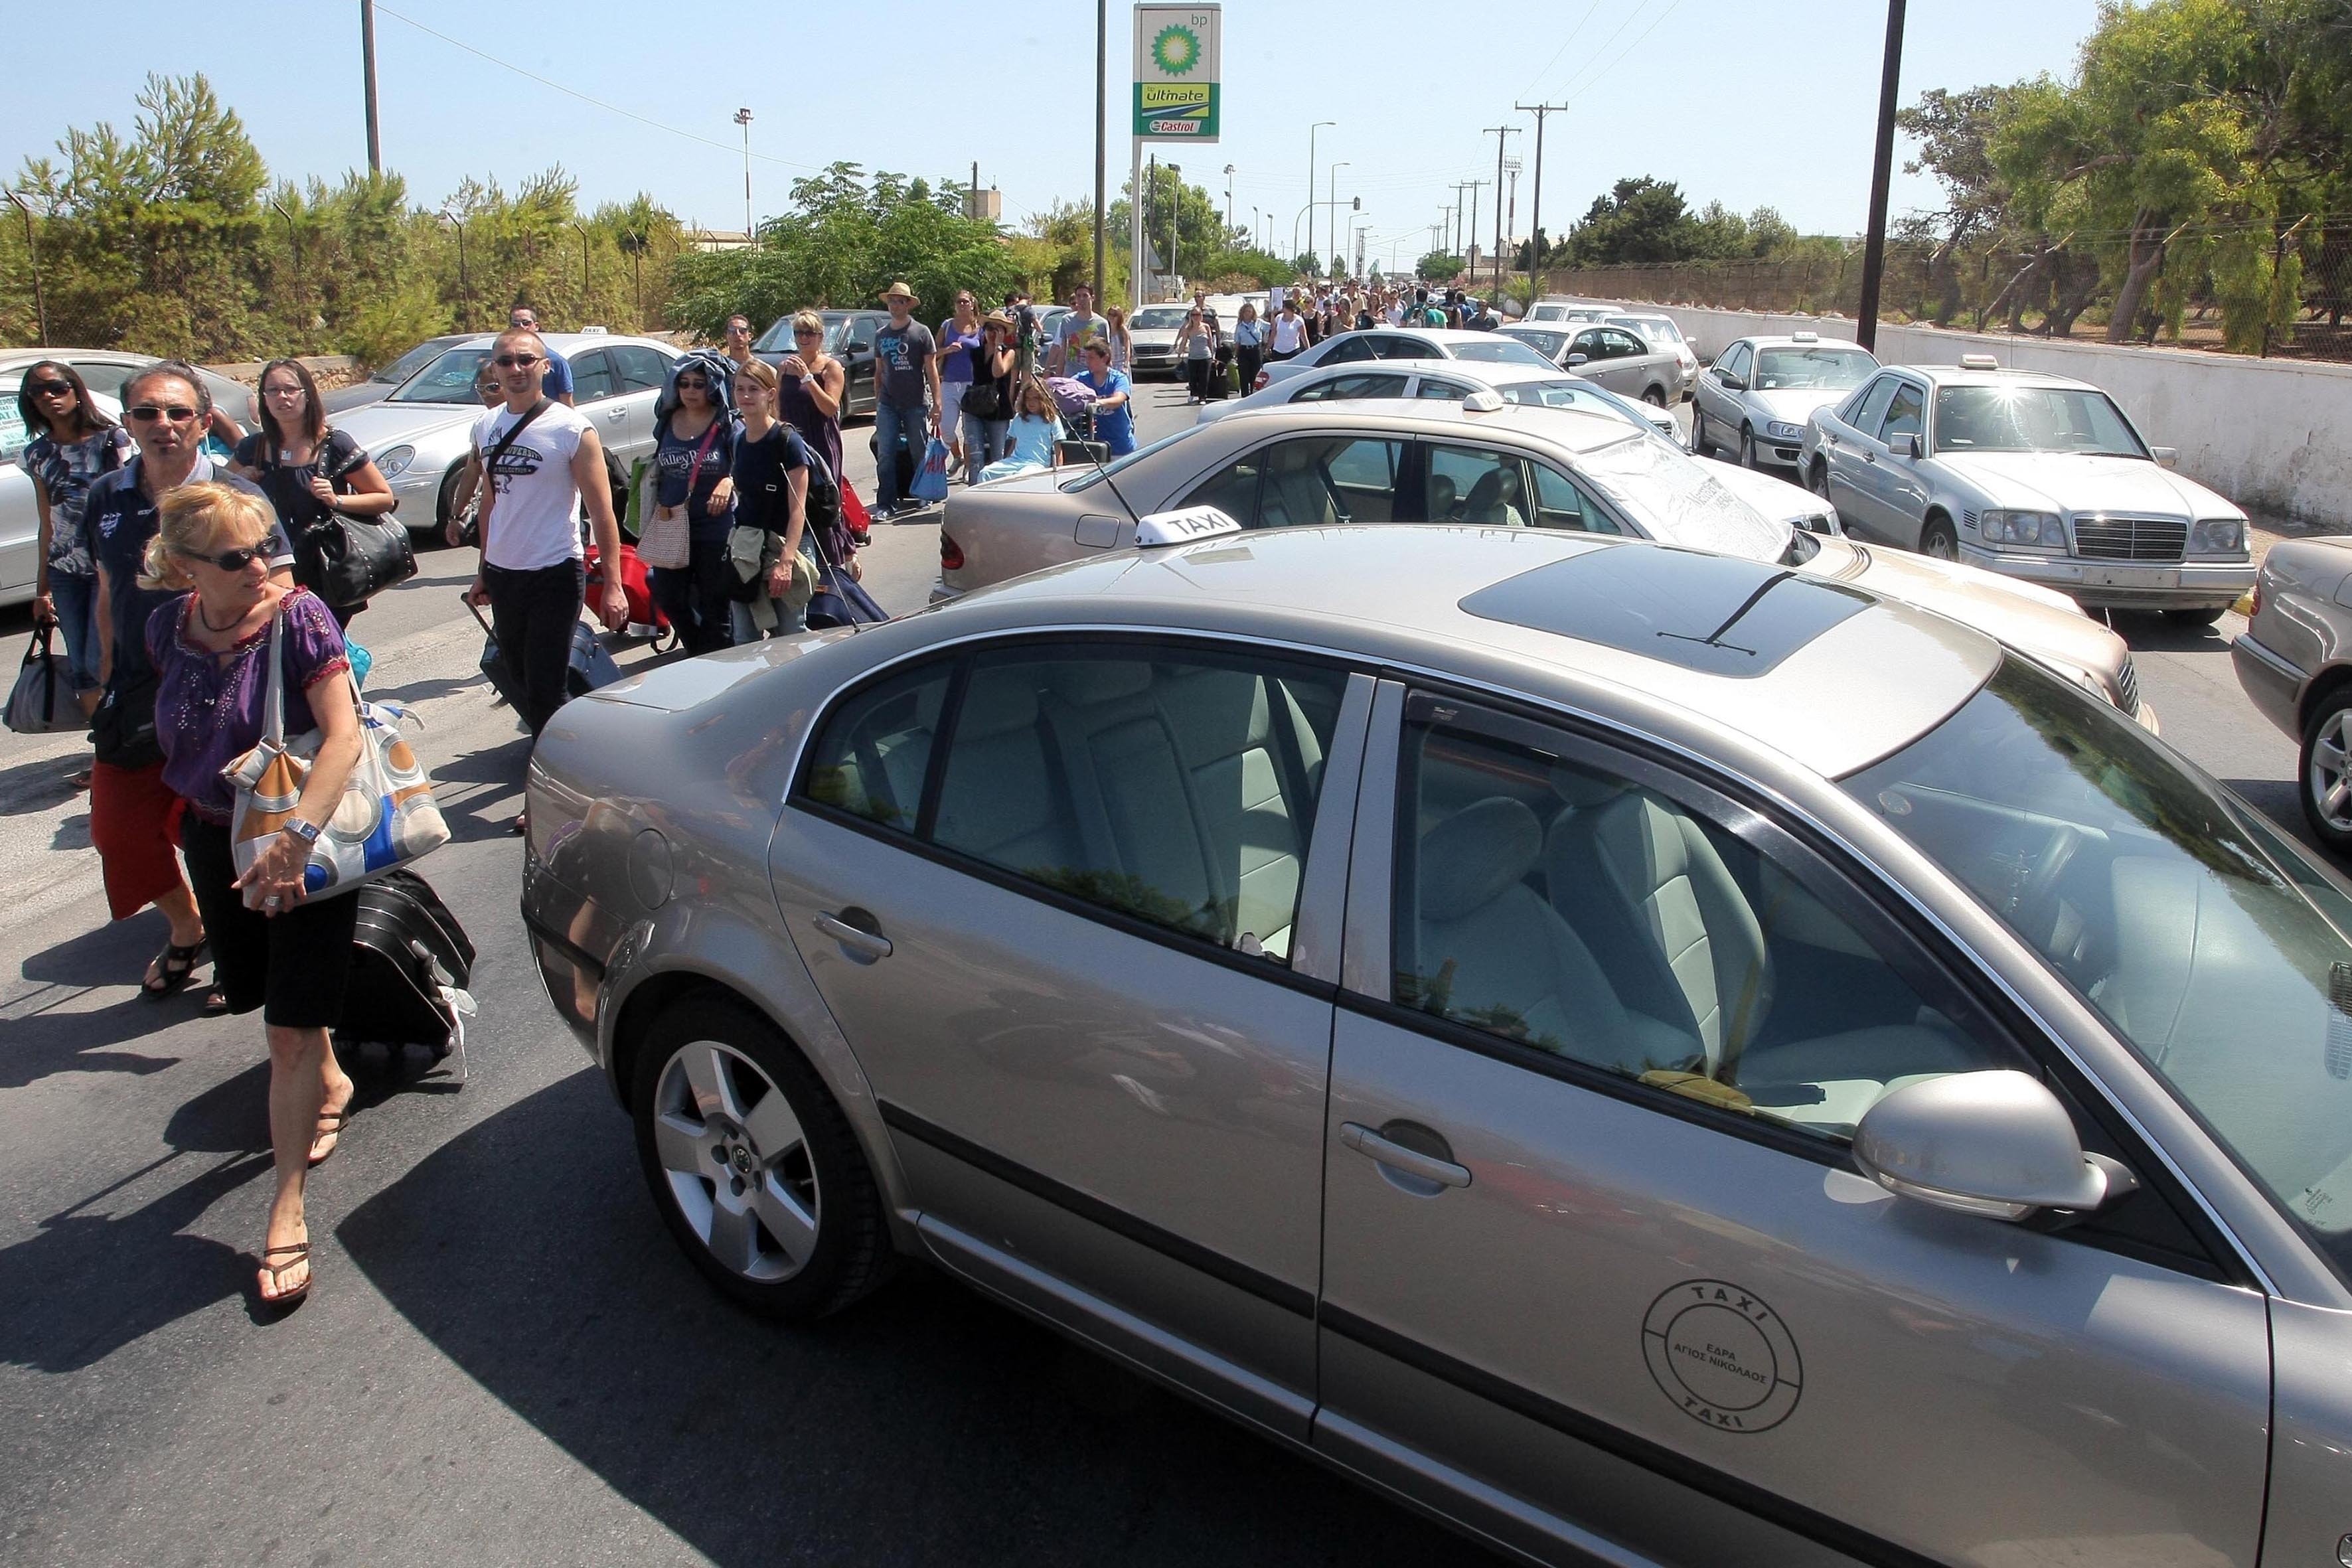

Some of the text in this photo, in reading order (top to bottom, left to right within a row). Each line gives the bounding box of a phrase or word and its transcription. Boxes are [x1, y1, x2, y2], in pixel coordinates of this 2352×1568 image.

[1192, 13, 1208, 27] bp
[1147, 90, 1204, 101] ultimate
[1161, 121, 1195, 131] Castrol
[659, 453, 689, 469] Valley
[1166, 512, 1230, 534] TAXI
[1691, 1287, 1767, 1321] TAXI
[1706, 1344, 1736, 1361] ΕΔΡΑ
[1674, 1343, 1768, 1384] ΑΓΙΟΣ ΝΙΚΟΛΑΟΣ
[1684, 1396, 1743, 1428] TAXI
